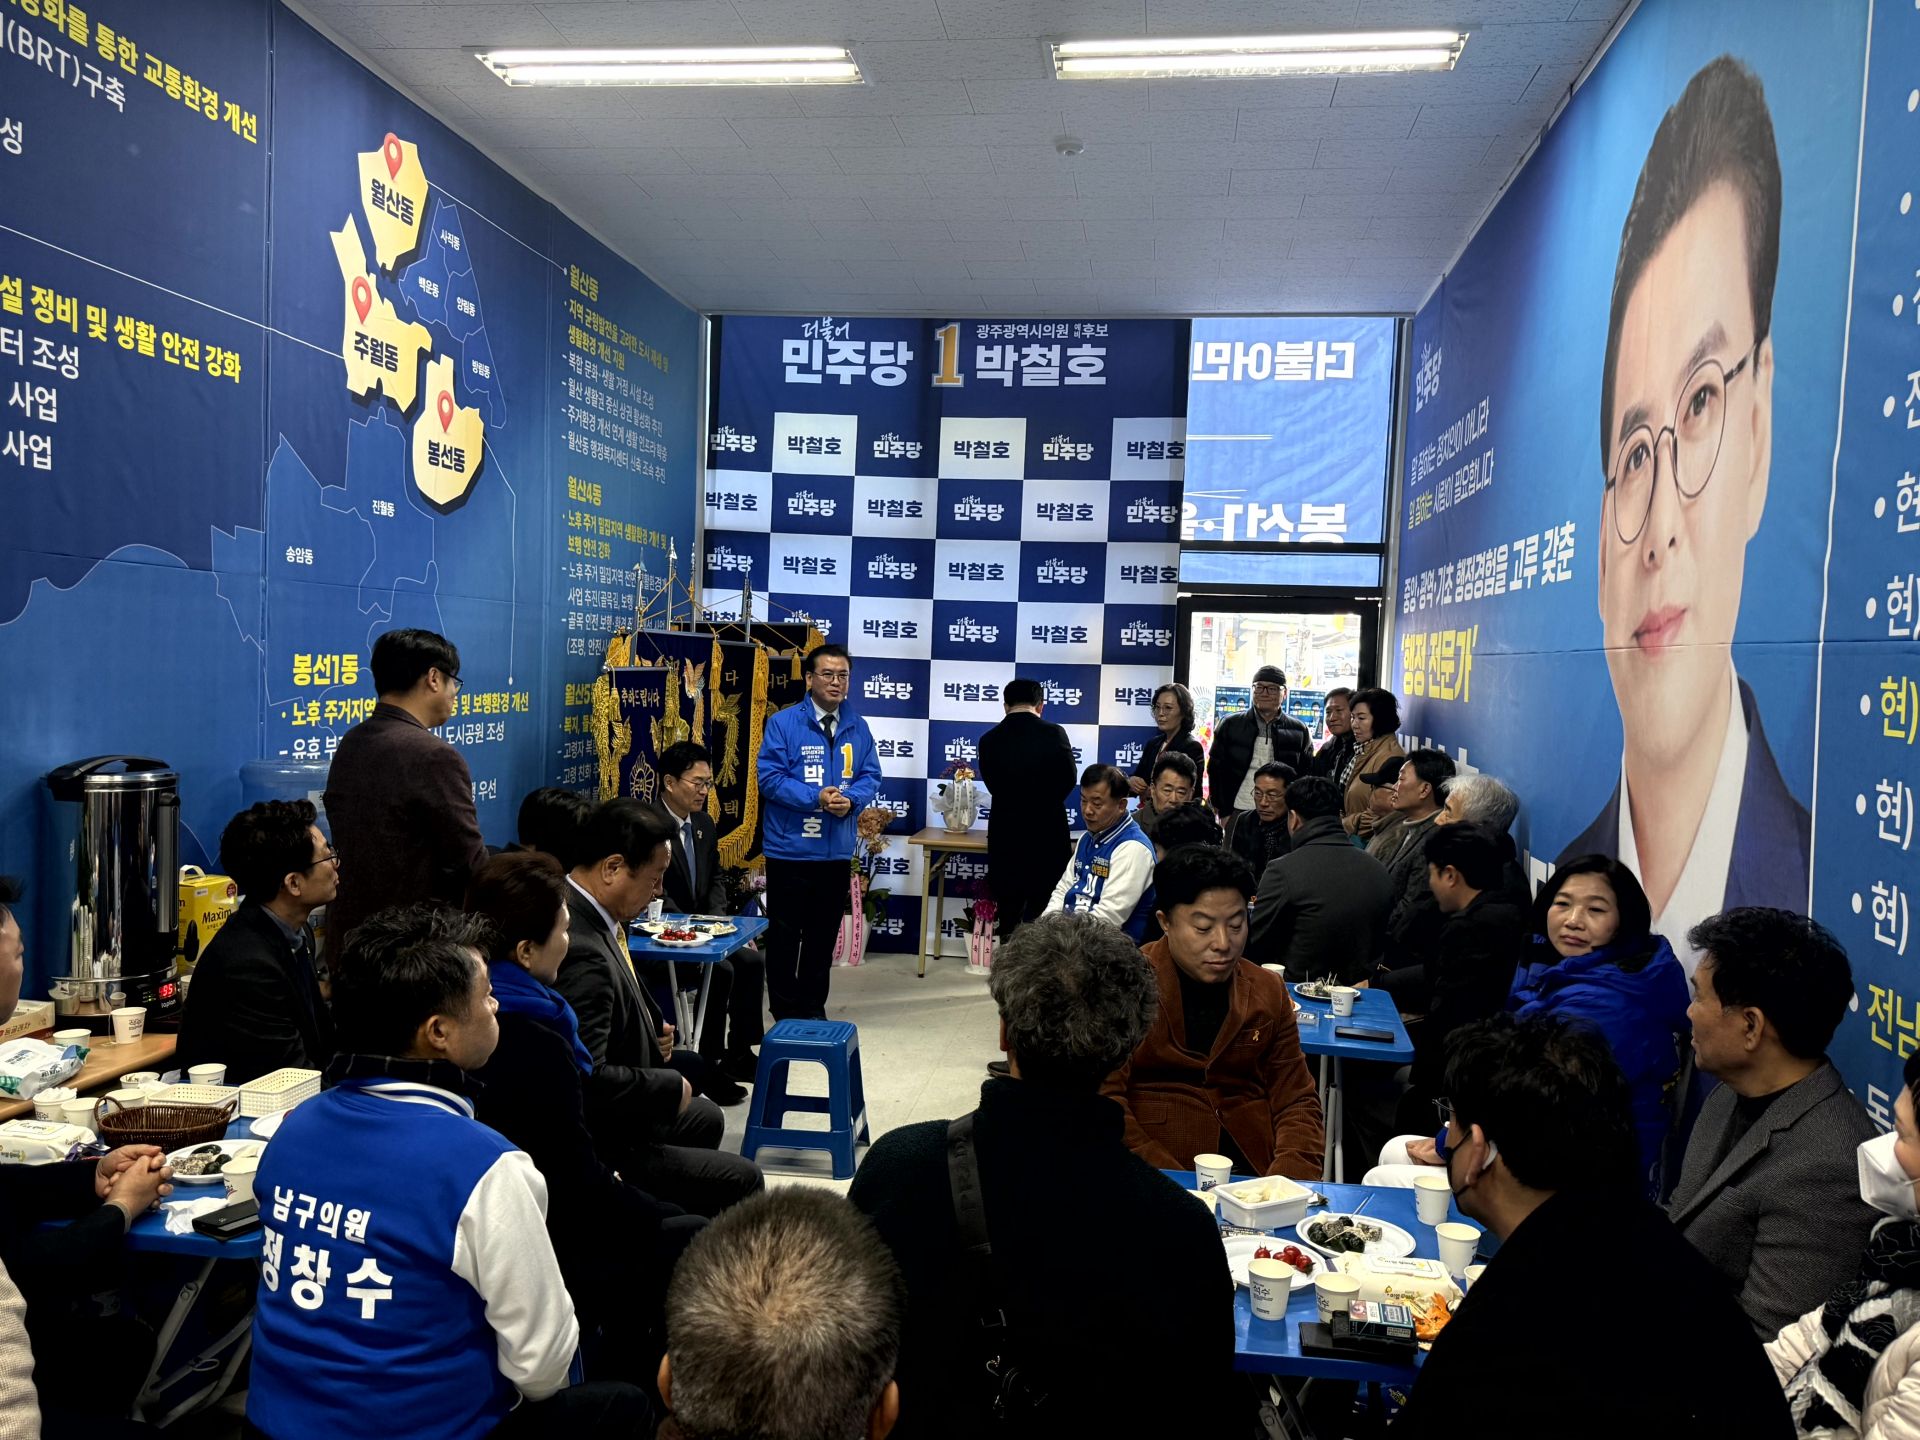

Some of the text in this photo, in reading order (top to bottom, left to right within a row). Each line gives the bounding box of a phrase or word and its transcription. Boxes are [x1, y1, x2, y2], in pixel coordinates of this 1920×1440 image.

[96, 22, 257, 144] 통한 교통환경 개선
[371, 178, 414, 226] 월산동
[440, 229, 460, 251] 사직동
[418, 276, 440, 298] 백운동
[570, 264, 599, 302] 월산동
[457, 297, 476, 317] 양림동
[31, 285, 78, 333] 정비
[86, 304, 107, 342] 및
[114, 315, 156, 357] 생활
[162, 332, 200, 371] 안전
[205, 345, 241, 384] 강화
[801, 316, 850, 342] 더불어
[976, 324, 1069, 339] 광주광역시의원
[33, 337, 79, 380] 조성
[354, 331, 398, 373] 주월동
[782, 339, 914, 387] 민주당
[931, 322, 965, 387] 1
[472, 360, 490, 379] 방림동
[976, 344, 1107, 387] 박철호
[1416, 347, 1442, 413] 민주당
[8, 382, 57, 423] 사업
[568, 404, 596, 432] 주거환경
[1464, 396, 1490, 446] 아니라
[3, 430, 52, 470] 사업
[568, 430, 590, 456] 월산동
[710, 433, 757, 452] 민주당
[788, 436, 841, 455] 박철호
[873, 440, 922, 459] 민주당
[954, 441, 1010, 459] 박철호
[1042, 443, 1094, 461] 민주당
[1127, 441, 1184, 460] 박철호
[428, 440, 465, 473] 봉선동
[568, 475, 602, 506] 월산4동
[1433, 474, 1454, 514] 사람이
[1454, 447, 1494, 505] 필요합니다
[372, 500, 395, 517] 진월동
[705, 492, 758, 511] 박철호
[787, 498, 836, 516] 민주당
[867, 499, 923, 518] 박철호
[954, 503, 1004, 521] 민주당
[1036, 503, 1094, 521] 박철호
[568, 509, 583, 531] 노후
[1126, 505, 1178, 523] 민주당
[286, 546, 313, 565] 송암동
[567, 534, 582, 556] 보행
[583, 538, 597, 558] 안전
[568, 561, 583, 580] 노후
[584, 564, 598, 583] 주거
[706, 553, 753, 572] 민주당
[783, 556, 837, 575] 박철호
[867, 561, 918, 580] 민주당
[948, 562, 1005, 581] 박철호
[1455, 543, 1509, 603] 행정경험을
[1510, 534, 1539, 591] 고루
[1541, 520, 1576, 586] 갖춘
[1036, 566, 1088, 584] 민주당
[1120, 566, 1178, 584] 박철호
[567, 586, 583, 606] 사업
[568, 611, 584, 630] 골목
[863, 619, 918, 639] 박철호
[949, 624, 999, 643] 민주당
[1031, 625, 1088, 643] 박철호
[1120, 628, 1172, 647] 민주당
[293, 653, 359, 686] 봉선1동
[863, 681, 913, 700] 민주당
[943, 683, 1000, 702] 박철호
[1115, 687, 1152, 706] 박철
[292, 700, 321, 727] 노후
[461, 693, 471, 716] 및
[473, 692, 509, 714] 보행환경
[512, 692, 529, 713] 개선
[1880, 676, 1918, 745] 현)
[446, 721, 484, 746] 도시공원
[486, 720, 505, 742] 조성
[292, 738, 321, 760] 유휴
[876, 739, 914, 758] 철호
[945, 744, 978, 762] 민주
[840, 743, 854, 779] 1
[479, 778, 497, 800] 우선
[1875, 778, 1913, 851] 현)
[202, 907, 232, 924] Maxim
[1871, 881, 1908, 956] 현)
[273, 1186, 371, 1244] 남구의원
[262, 1226, 393, 1319] 정창수
